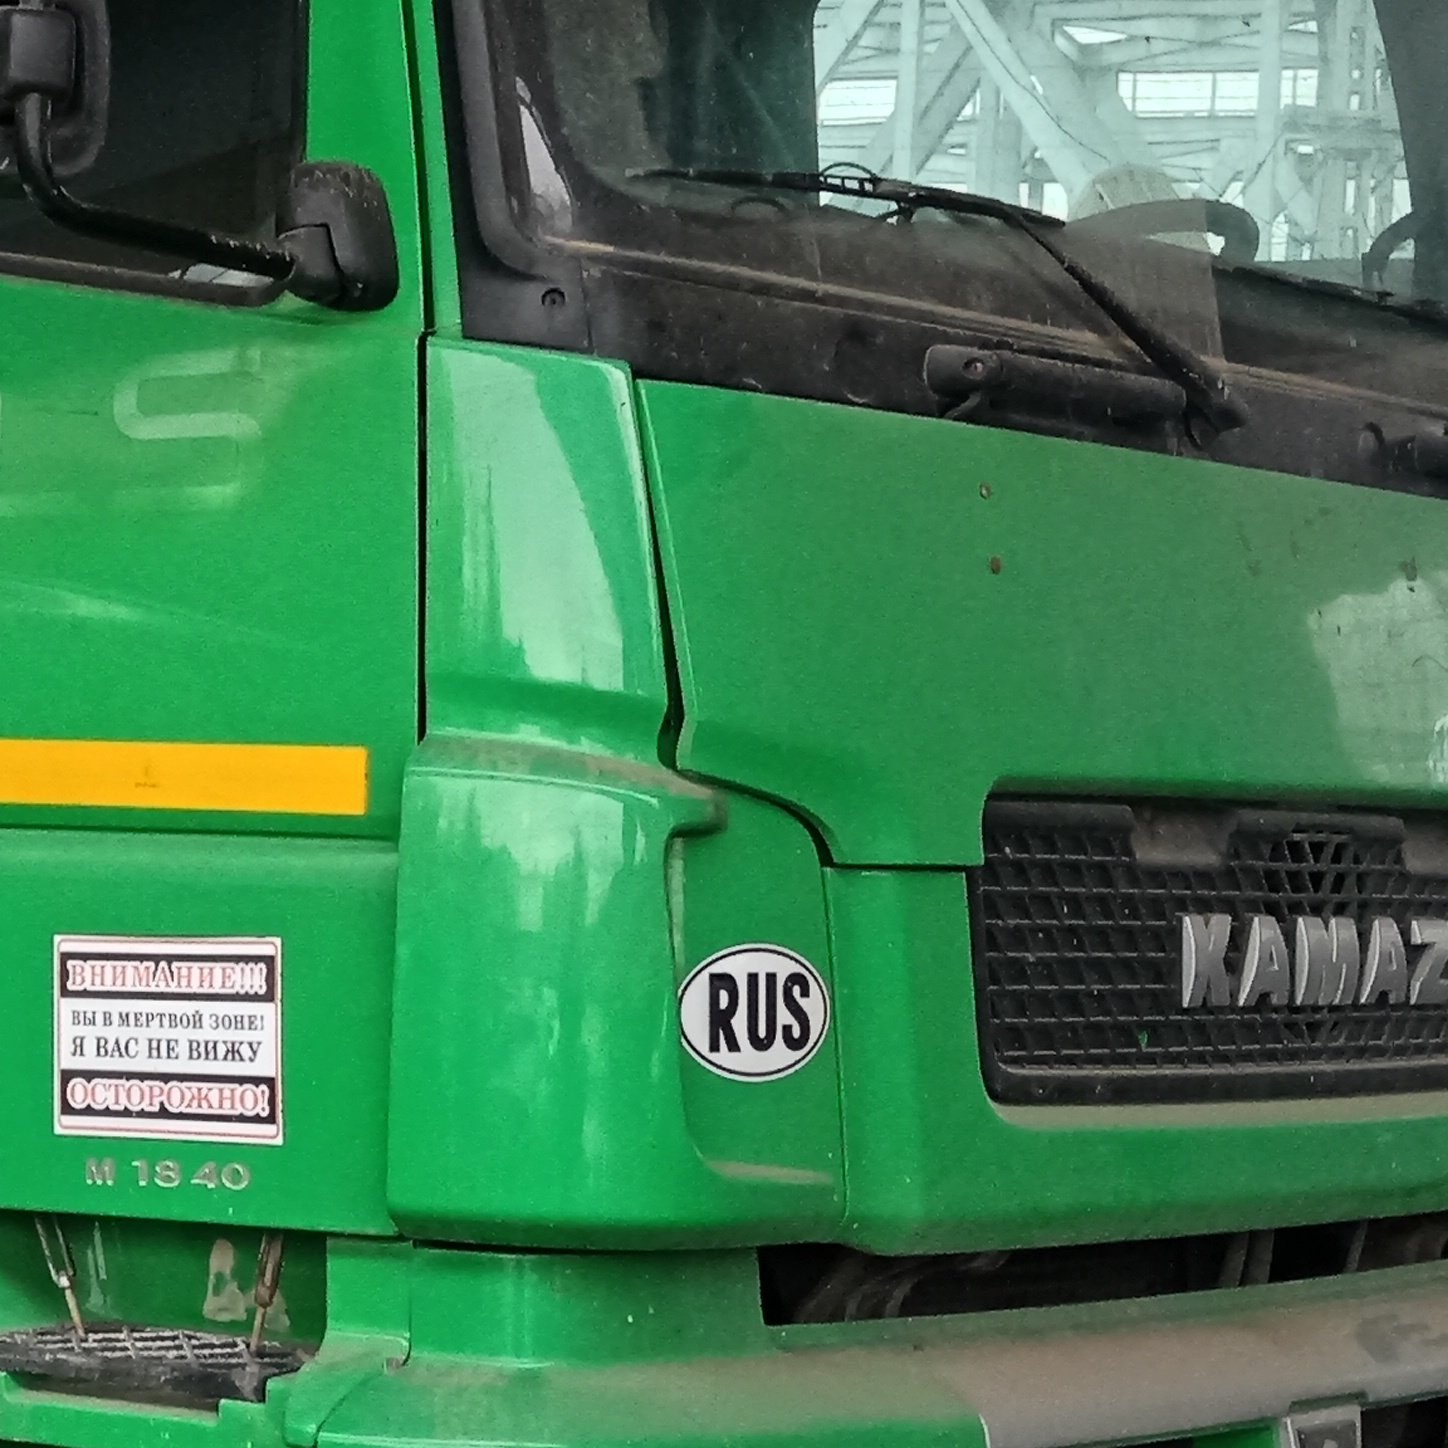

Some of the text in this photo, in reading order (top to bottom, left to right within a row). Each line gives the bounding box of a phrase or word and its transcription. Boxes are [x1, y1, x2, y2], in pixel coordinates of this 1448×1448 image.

[69, 963, 265, 992] ВНИМАНИЕ!!!
[71, 1010, 265, 1031] ВЫ В МЕРТВОЙ ЗОНЕ!
[708, 971, 811, 1054] RUS
[70, 1036, 263, 1064] Я ВАС НЕ ВИЖУ
[70, 1081, 267, 1113] ОСТОРОЖНО!
[85, 1157, 116, 1187] M
